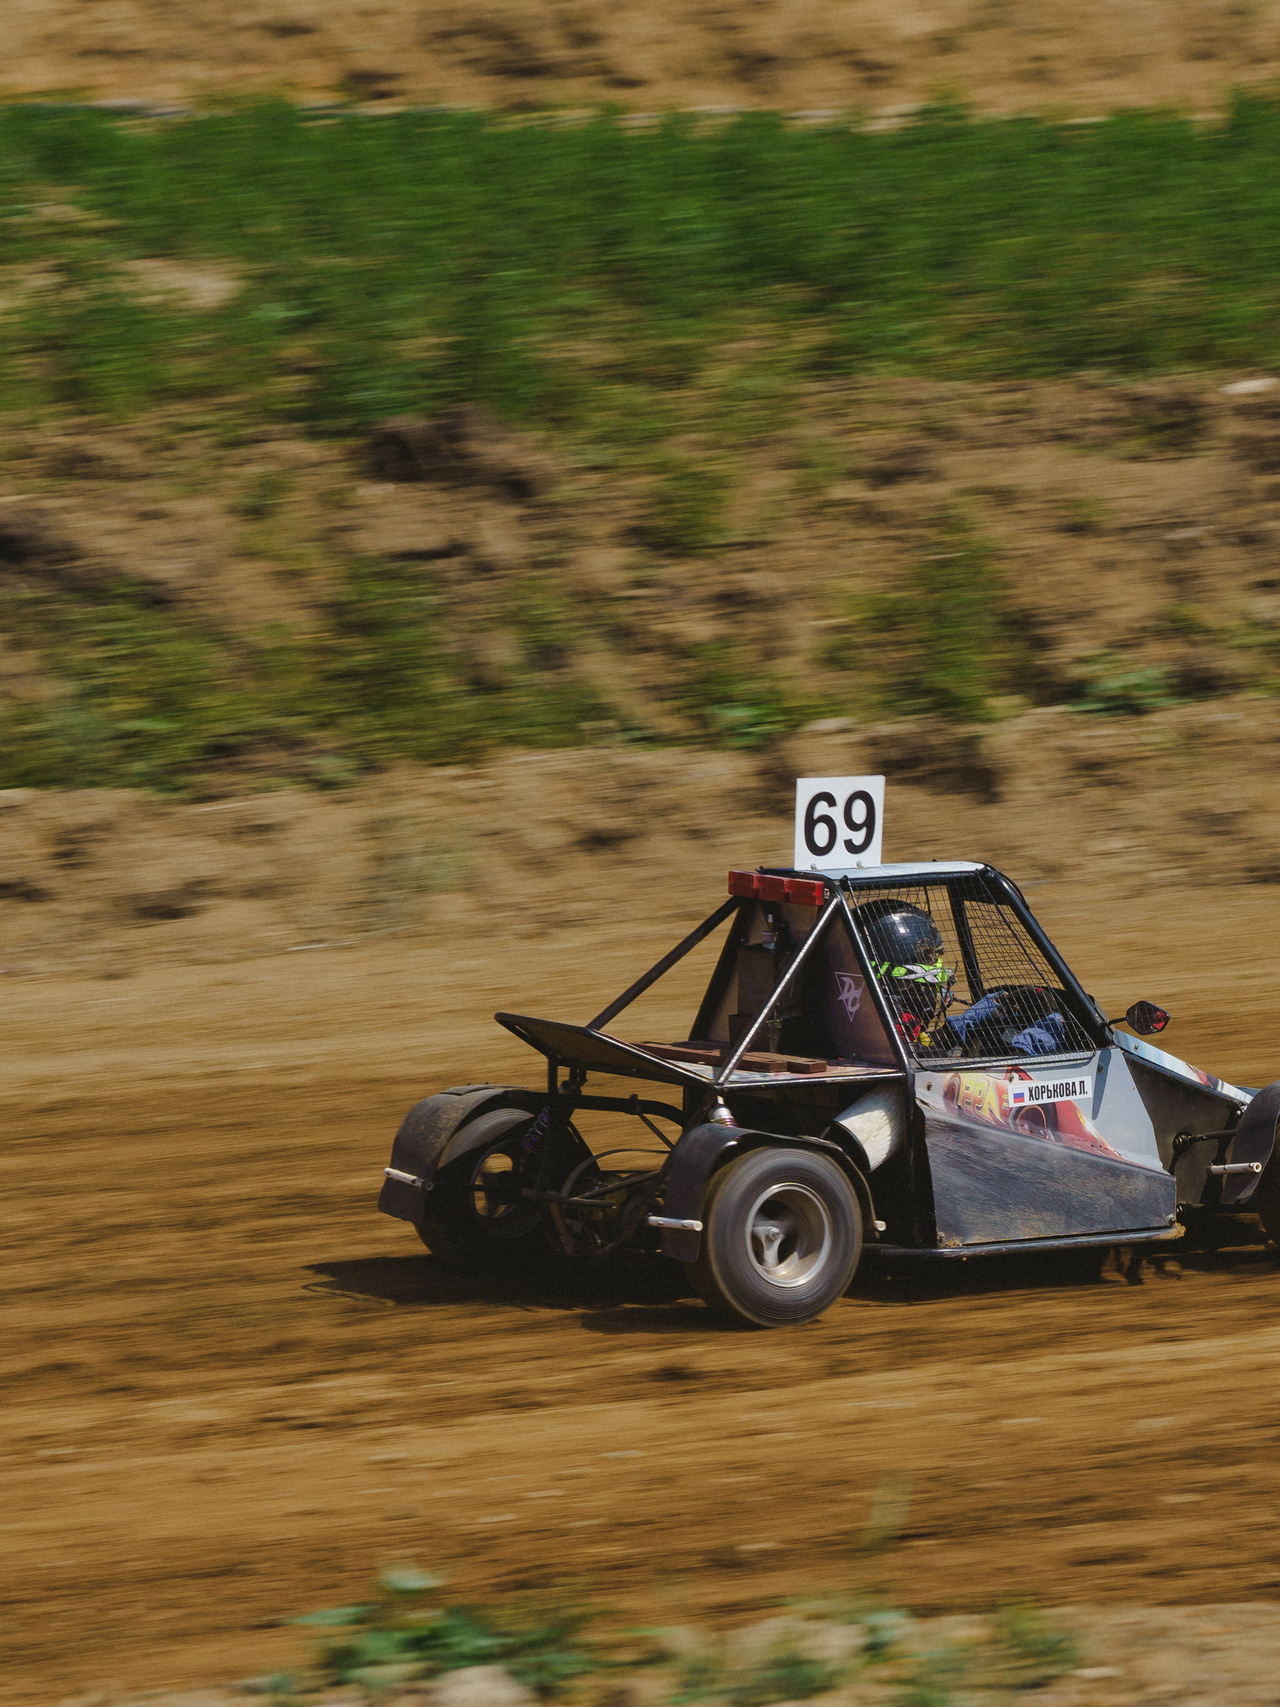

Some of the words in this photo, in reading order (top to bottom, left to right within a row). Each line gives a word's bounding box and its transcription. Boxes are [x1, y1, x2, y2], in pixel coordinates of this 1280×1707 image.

[804, 790, 876, 857] 69
[1028, 1081, 1077, 1101] ХОРЬКОВА
[1078, 1080, 1088, 1095] Л.
